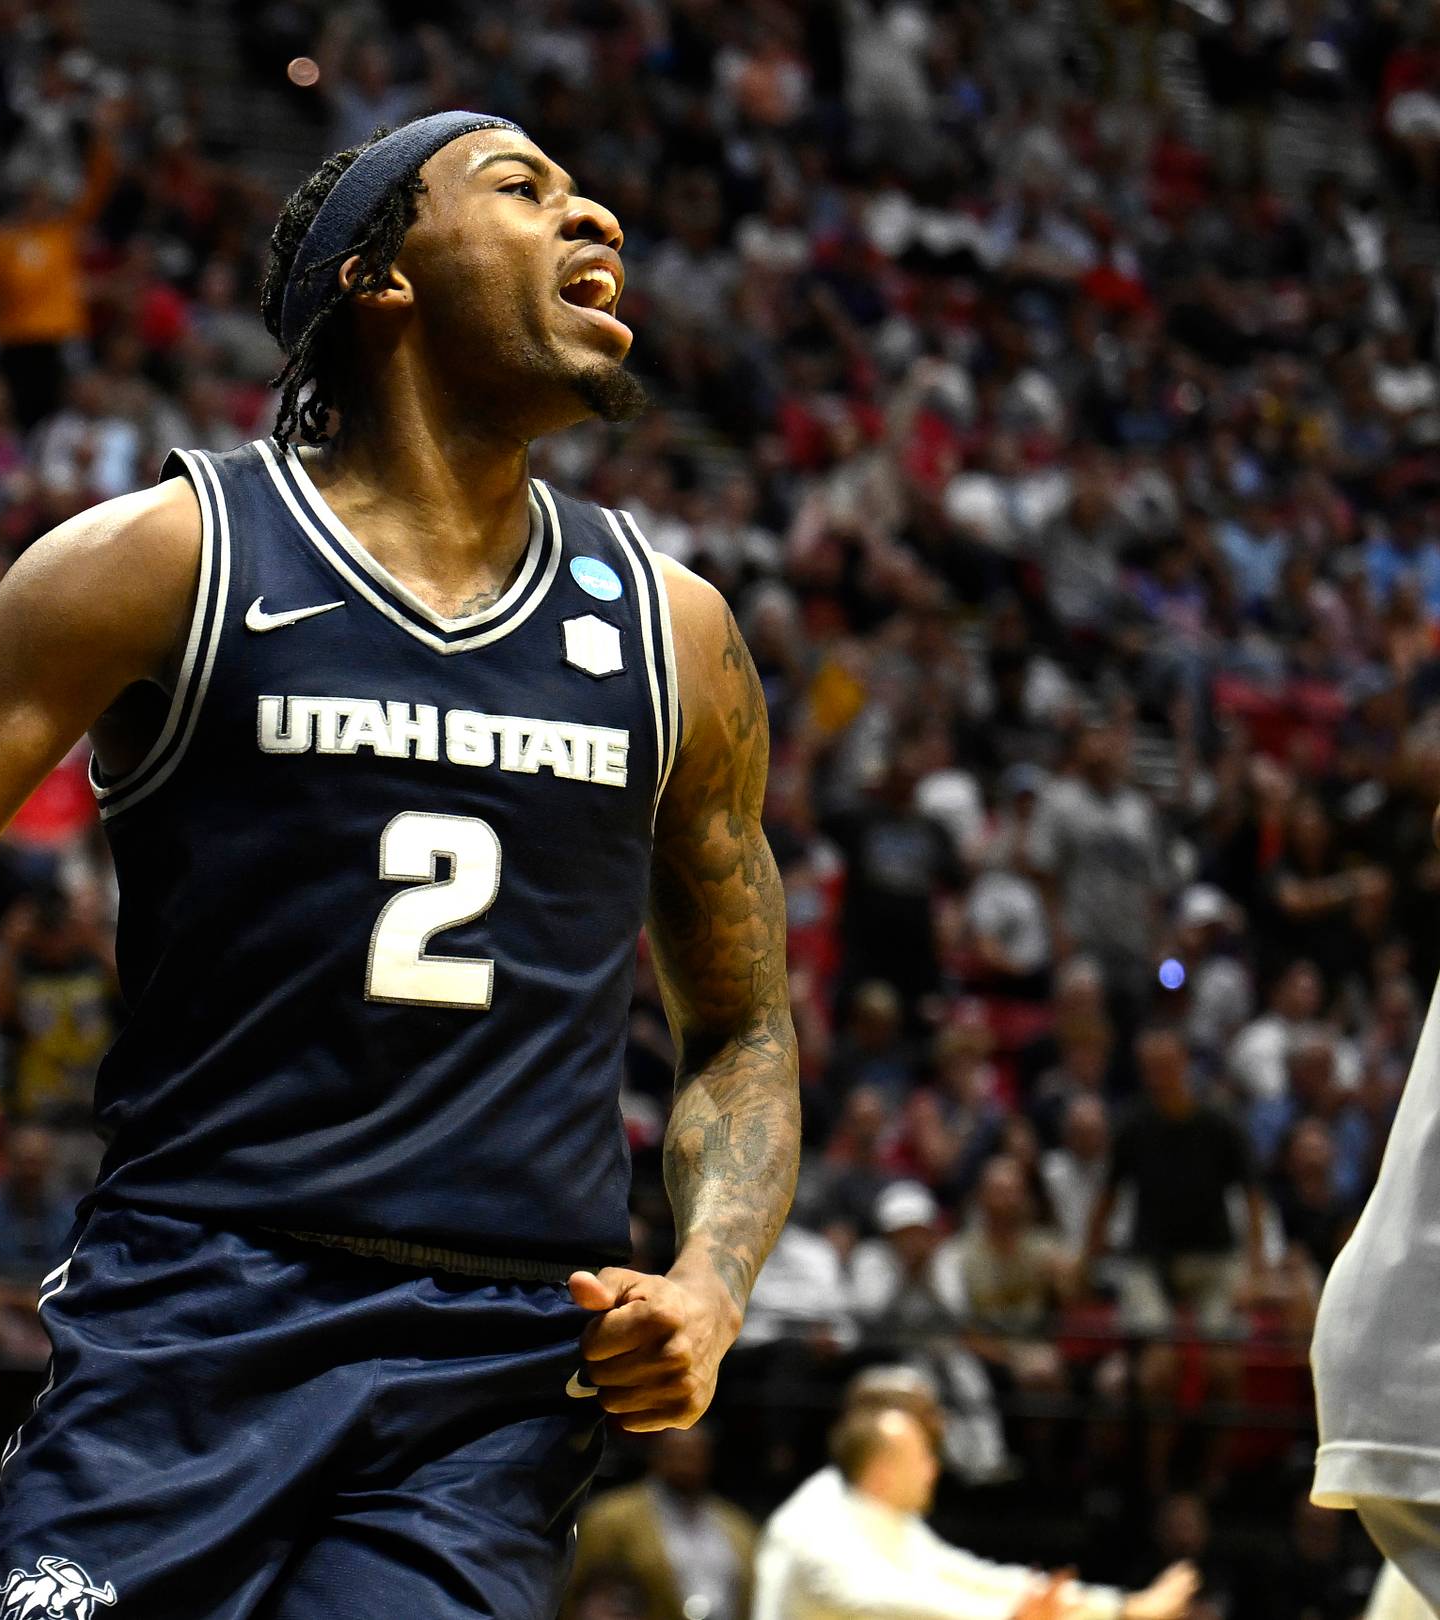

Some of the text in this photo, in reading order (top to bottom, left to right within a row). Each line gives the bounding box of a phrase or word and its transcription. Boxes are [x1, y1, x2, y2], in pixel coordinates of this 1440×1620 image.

[257, 695, 629, 787] UTAH STATE
[364, 811, 502, 1009] 2
